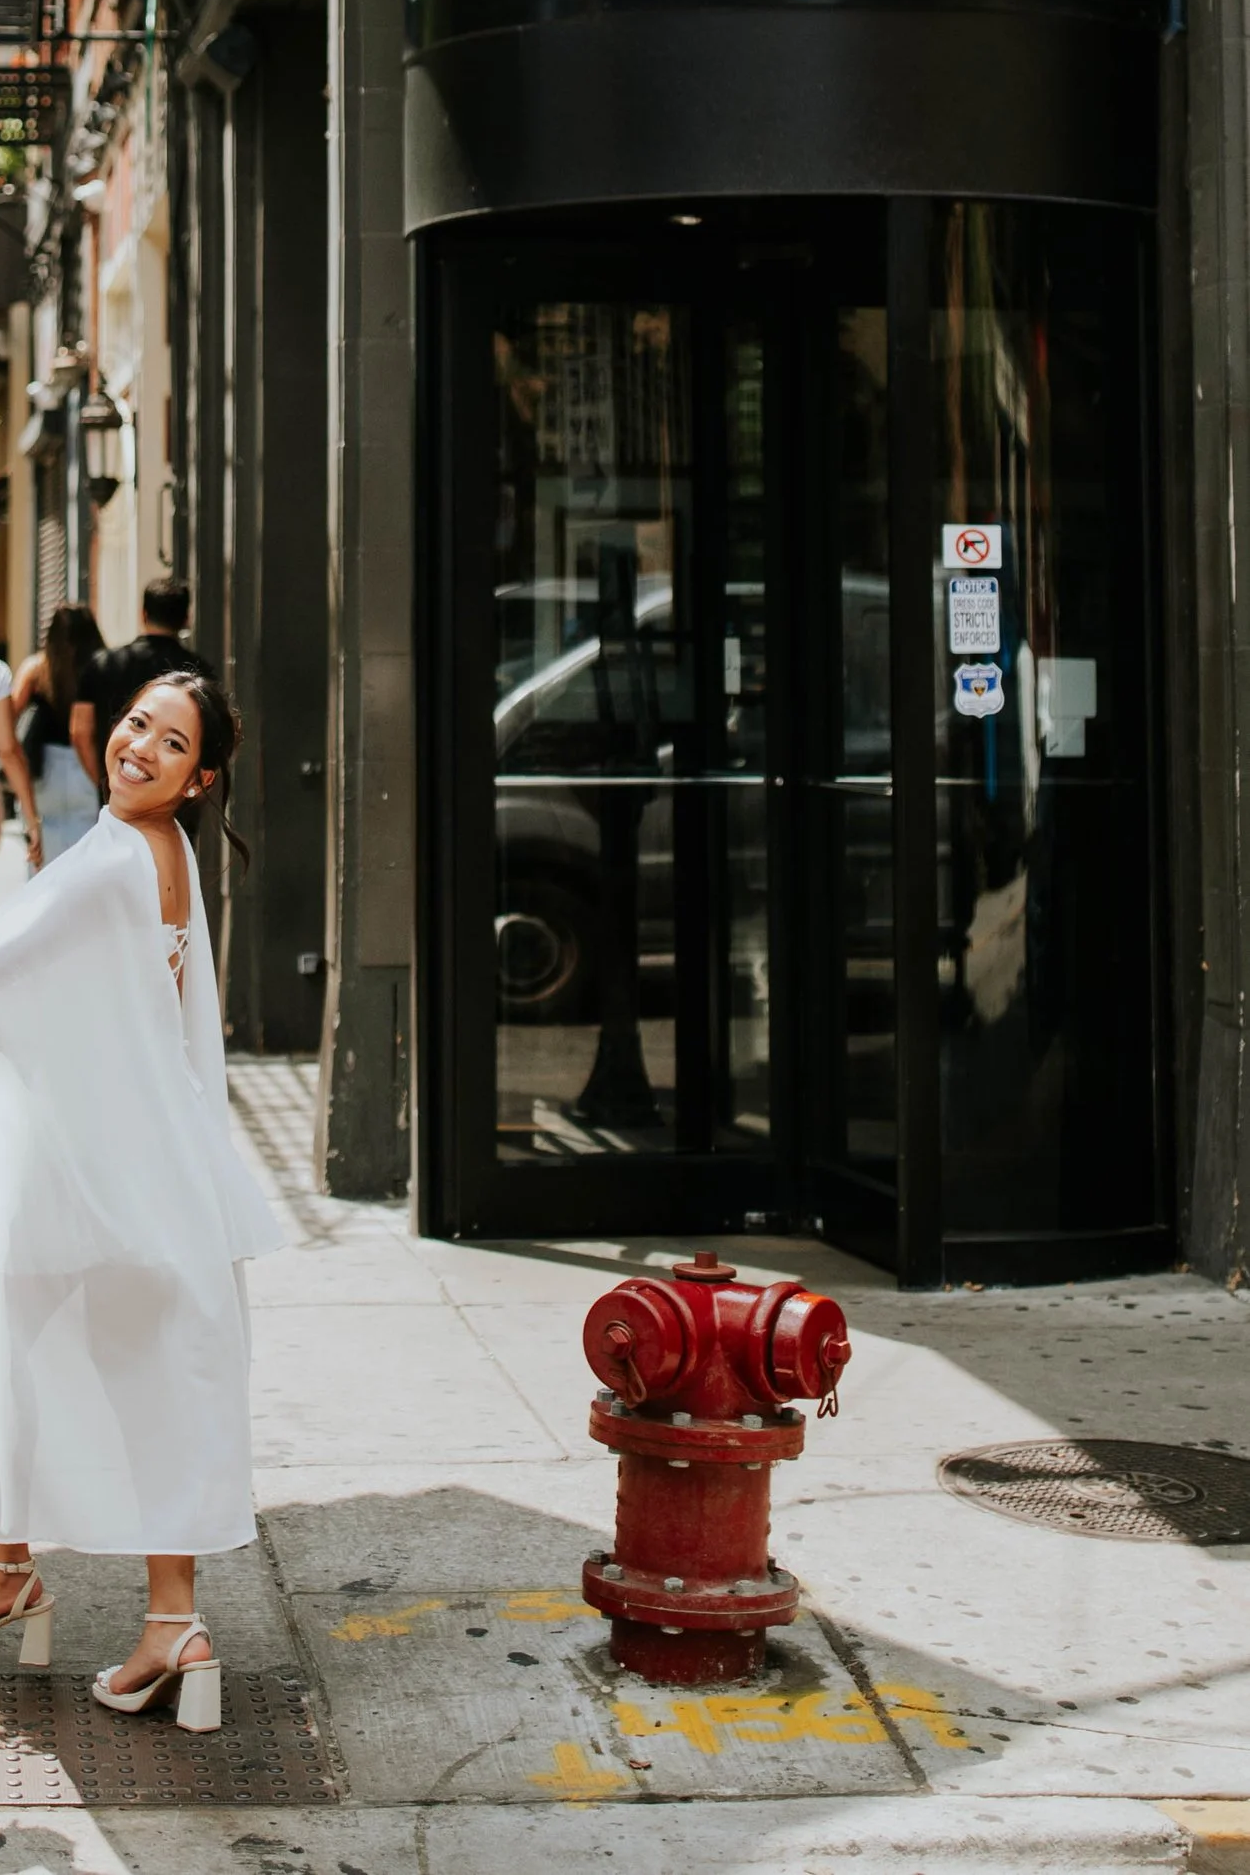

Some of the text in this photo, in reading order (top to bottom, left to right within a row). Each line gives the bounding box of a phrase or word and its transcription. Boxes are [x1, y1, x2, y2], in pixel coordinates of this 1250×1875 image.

[956, 580, 991, 594] NOTICE
[953, 612, 997, 628] STRICTLY
[954, 631, 997, 646] ENFORCED
